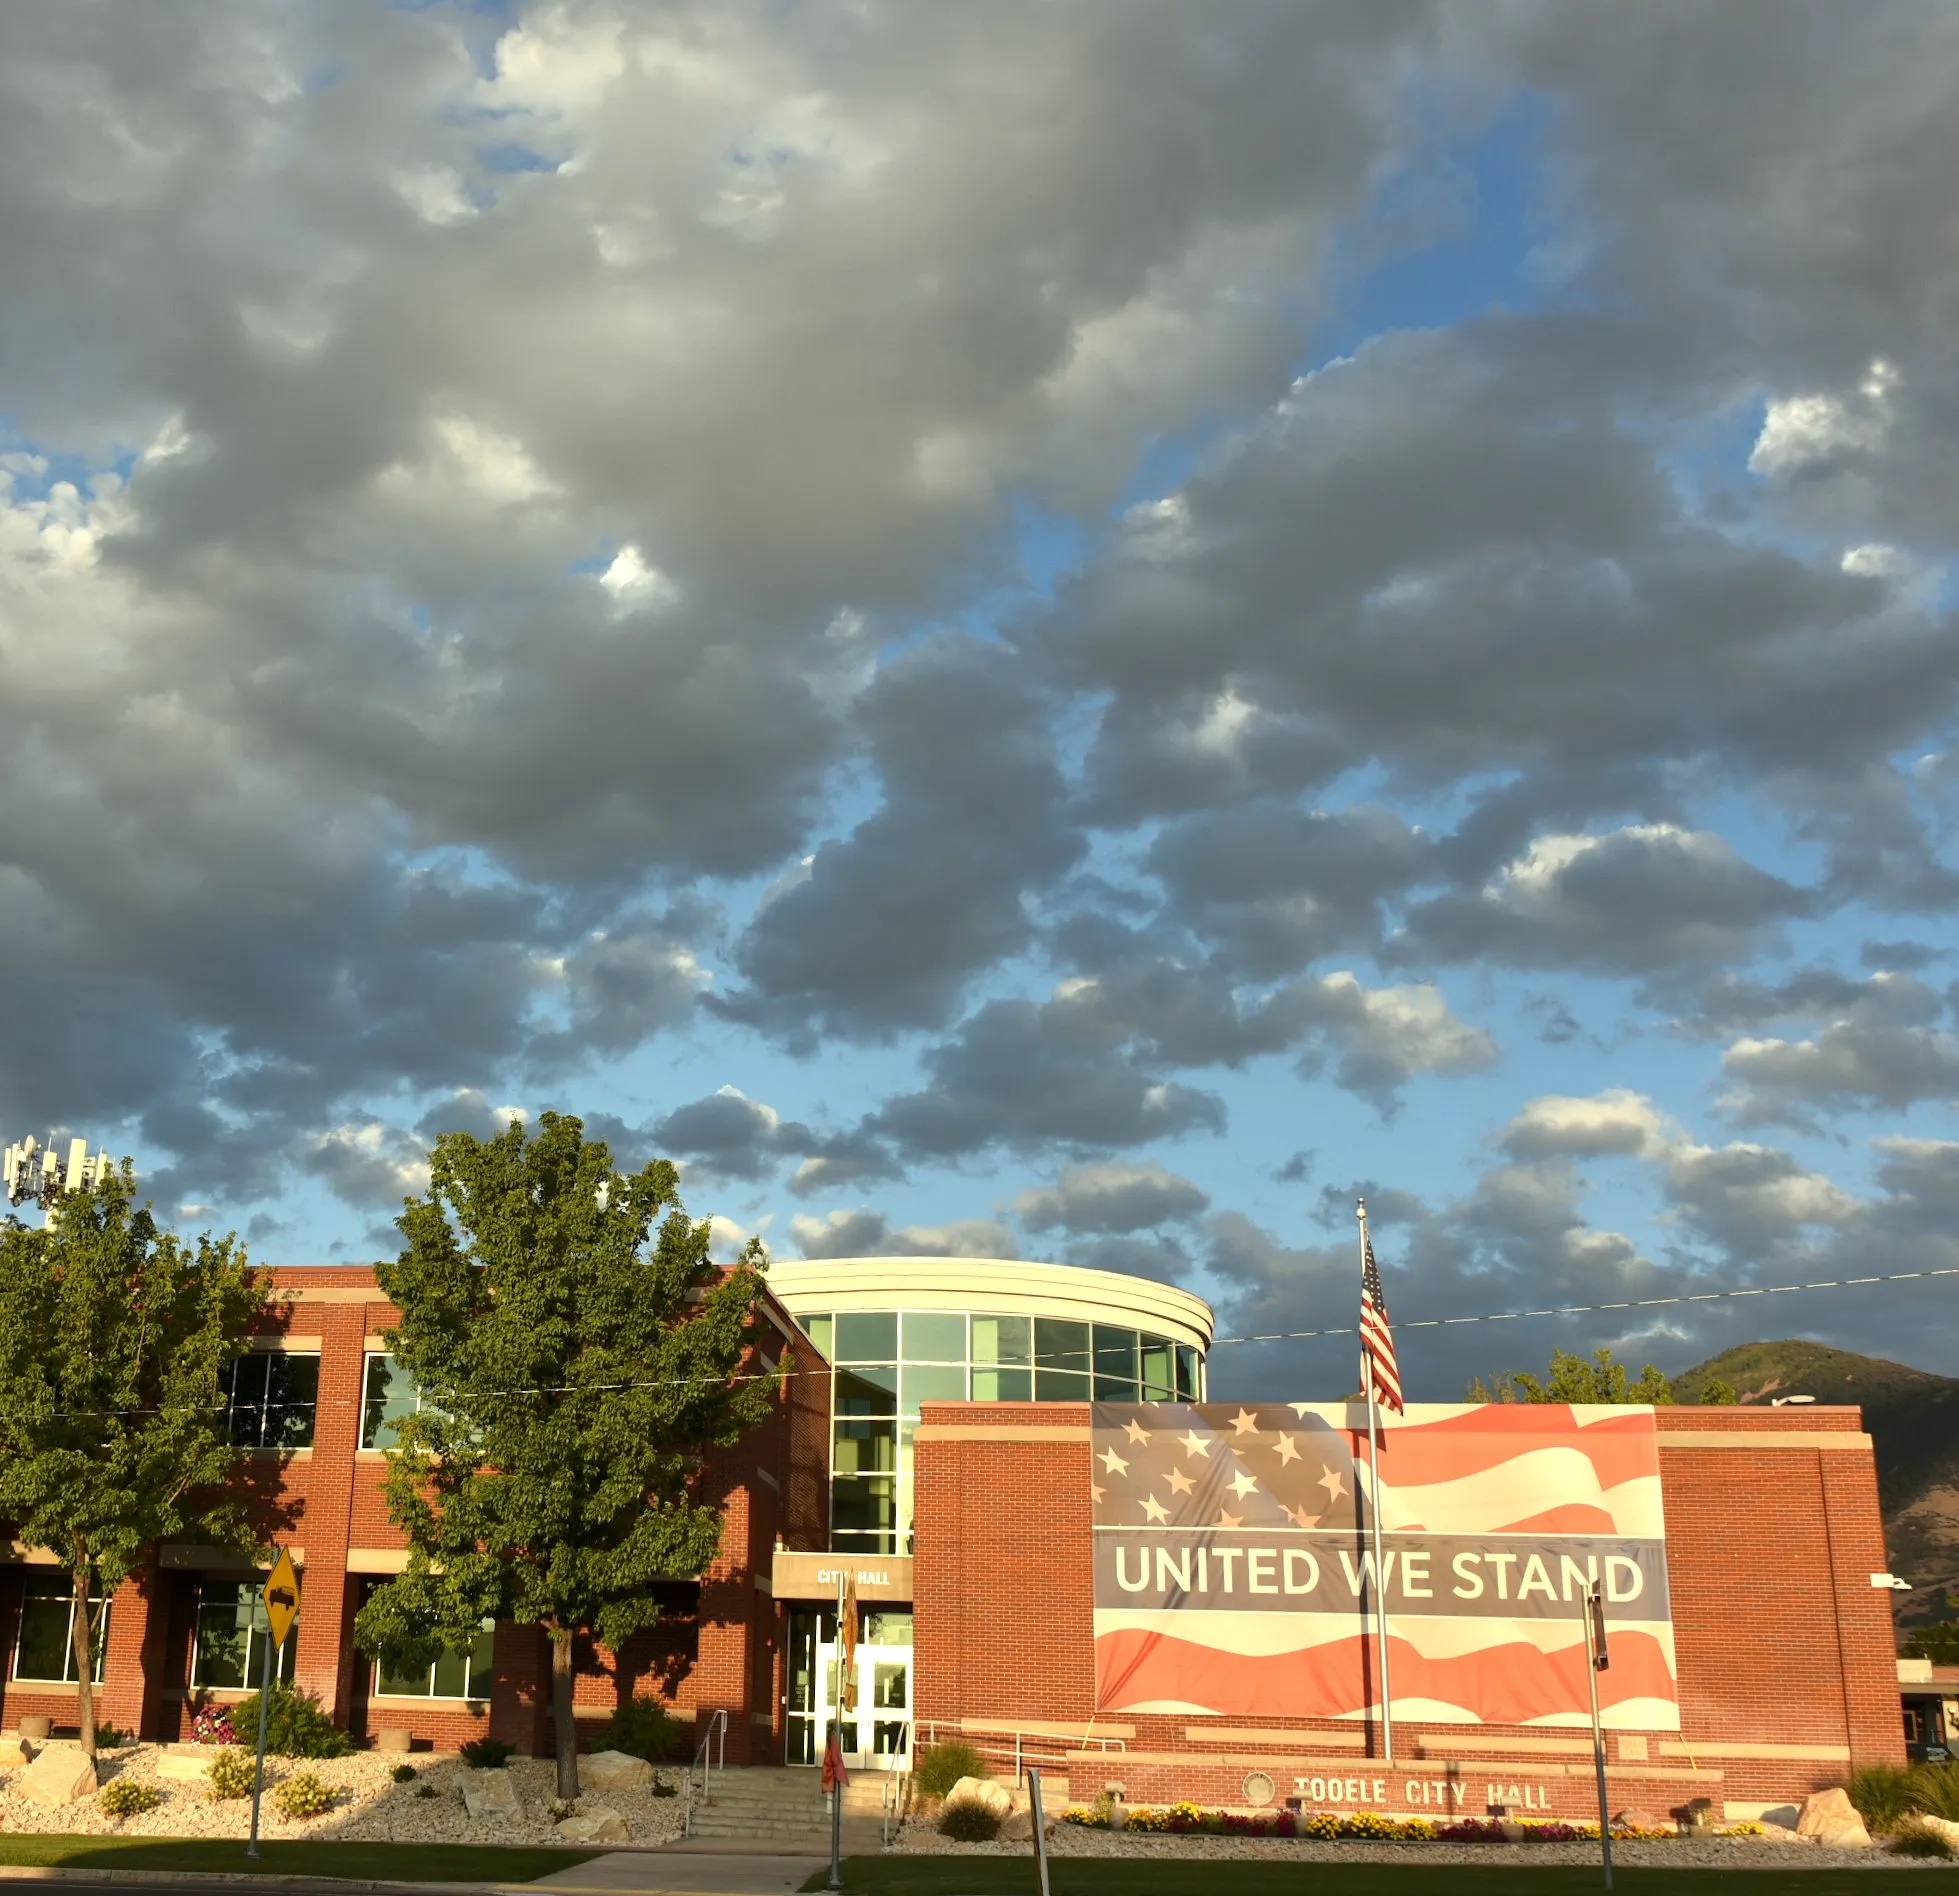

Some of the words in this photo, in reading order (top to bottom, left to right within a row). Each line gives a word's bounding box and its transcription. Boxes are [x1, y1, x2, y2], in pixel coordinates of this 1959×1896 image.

[857, 1571, 890, 1585] HALL
[1115, 1546, 1320, 1595] UNITED
[1338, 1550, 1433, 1599] WE
[1452, 1552, 1644, 1603] STAND
[1293, 1777, 1387, 1803] TOOELE
[1405, 1780, 1467, 1806] CITY
[1487, 1783, 1552, 1809] HALL
